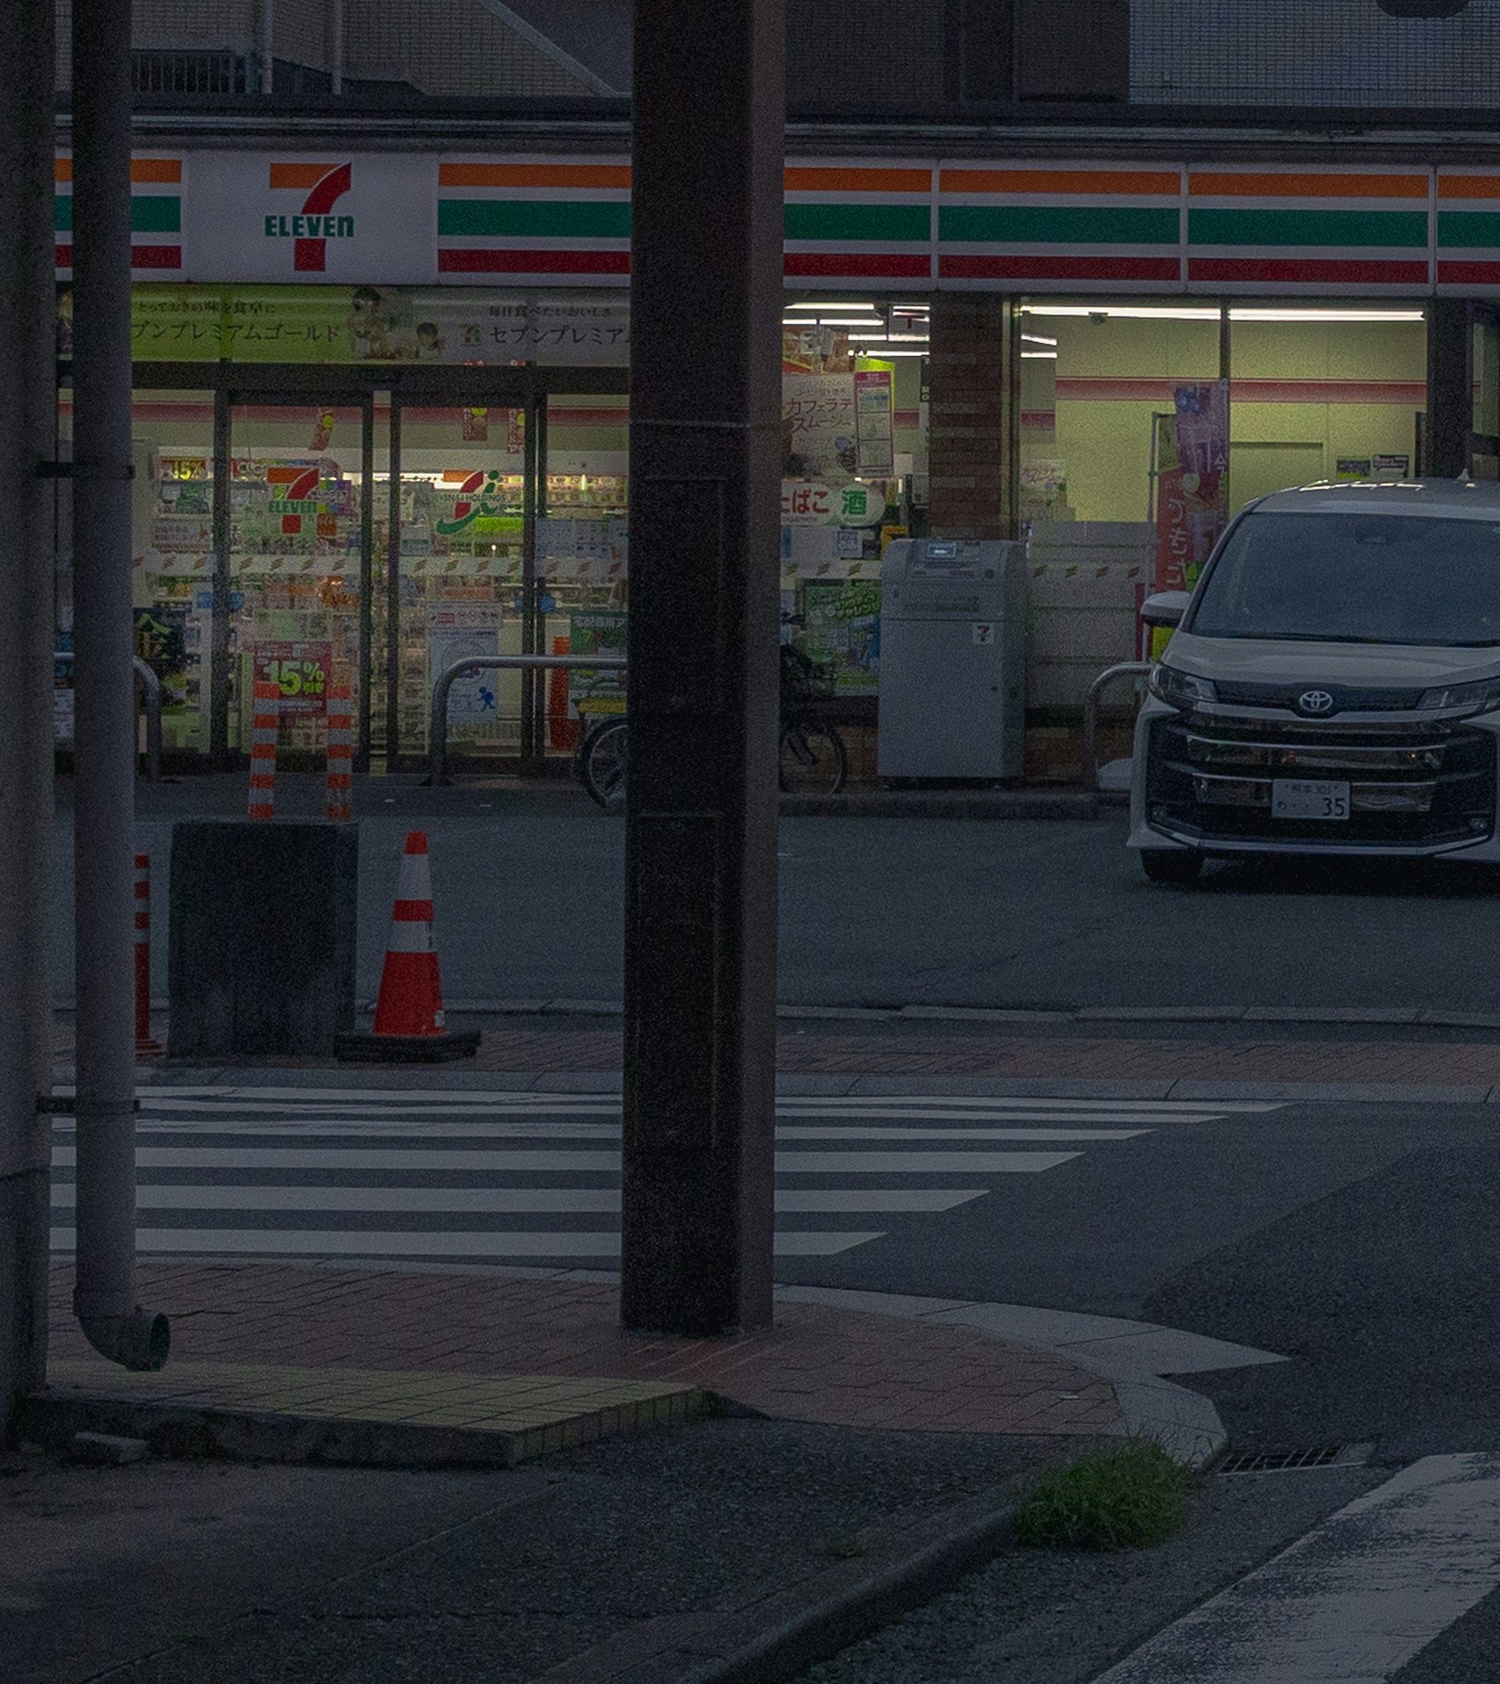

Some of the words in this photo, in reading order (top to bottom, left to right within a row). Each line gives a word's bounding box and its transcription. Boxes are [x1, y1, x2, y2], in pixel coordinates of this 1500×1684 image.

[490, 325, 631, 345] セブンプレミア
[842, 489, 867, 515] 酒
